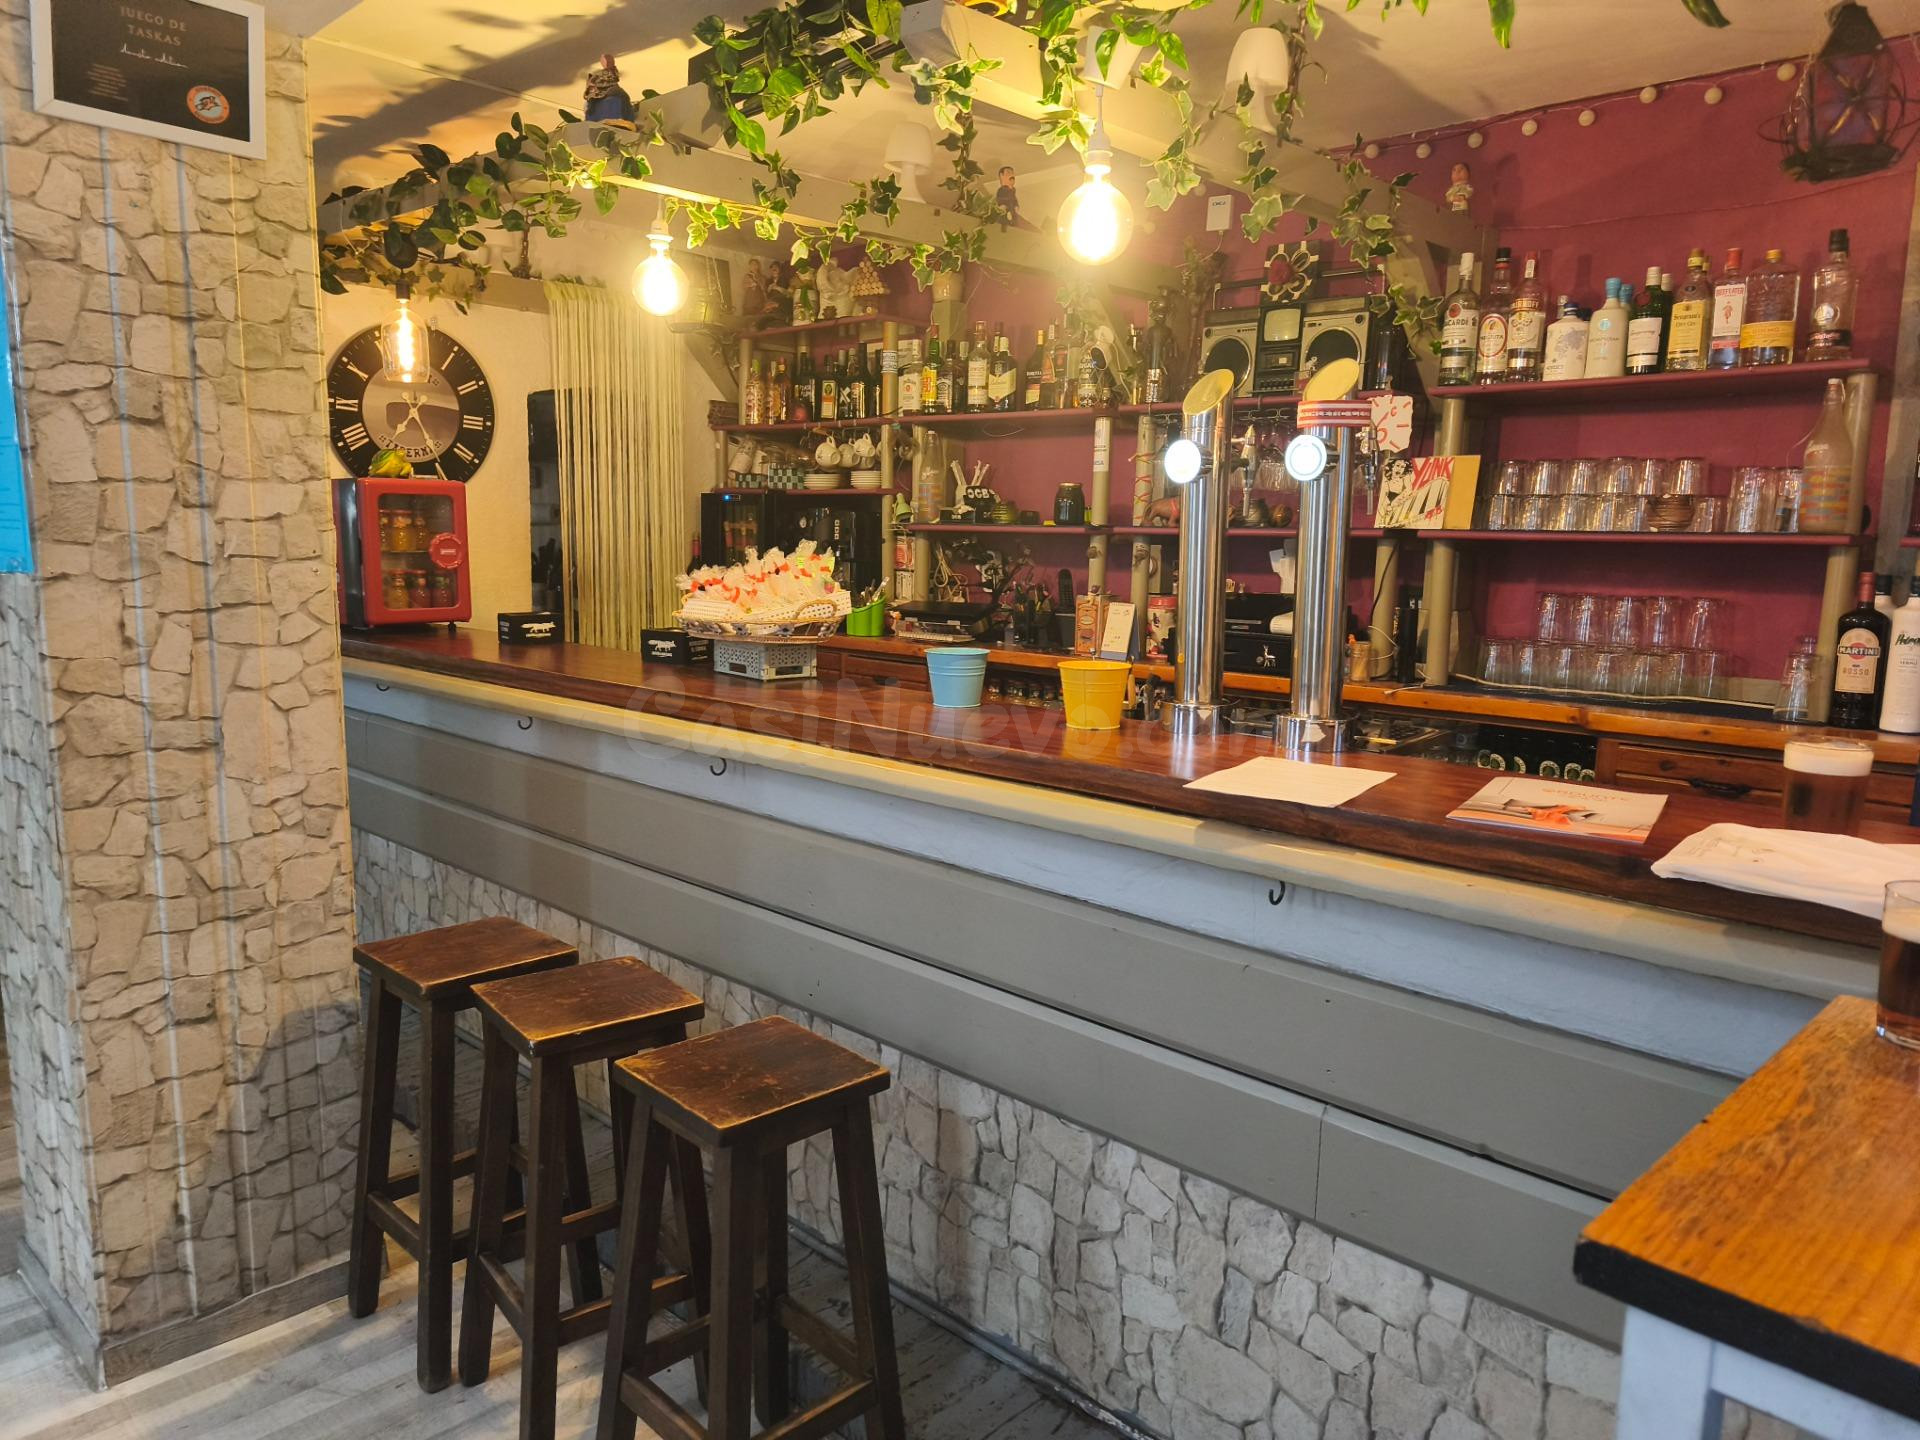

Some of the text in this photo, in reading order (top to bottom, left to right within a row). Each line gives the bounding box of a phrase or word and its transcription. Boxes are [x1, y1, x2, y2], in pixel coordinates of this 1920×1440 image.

[120, 6, 187, 32] JUEGO DE
[127, 24, 181, 46] TASKAS
[966, 487, 990, 499] OCB
[1839, 646, 1878, 656] MARTINI
